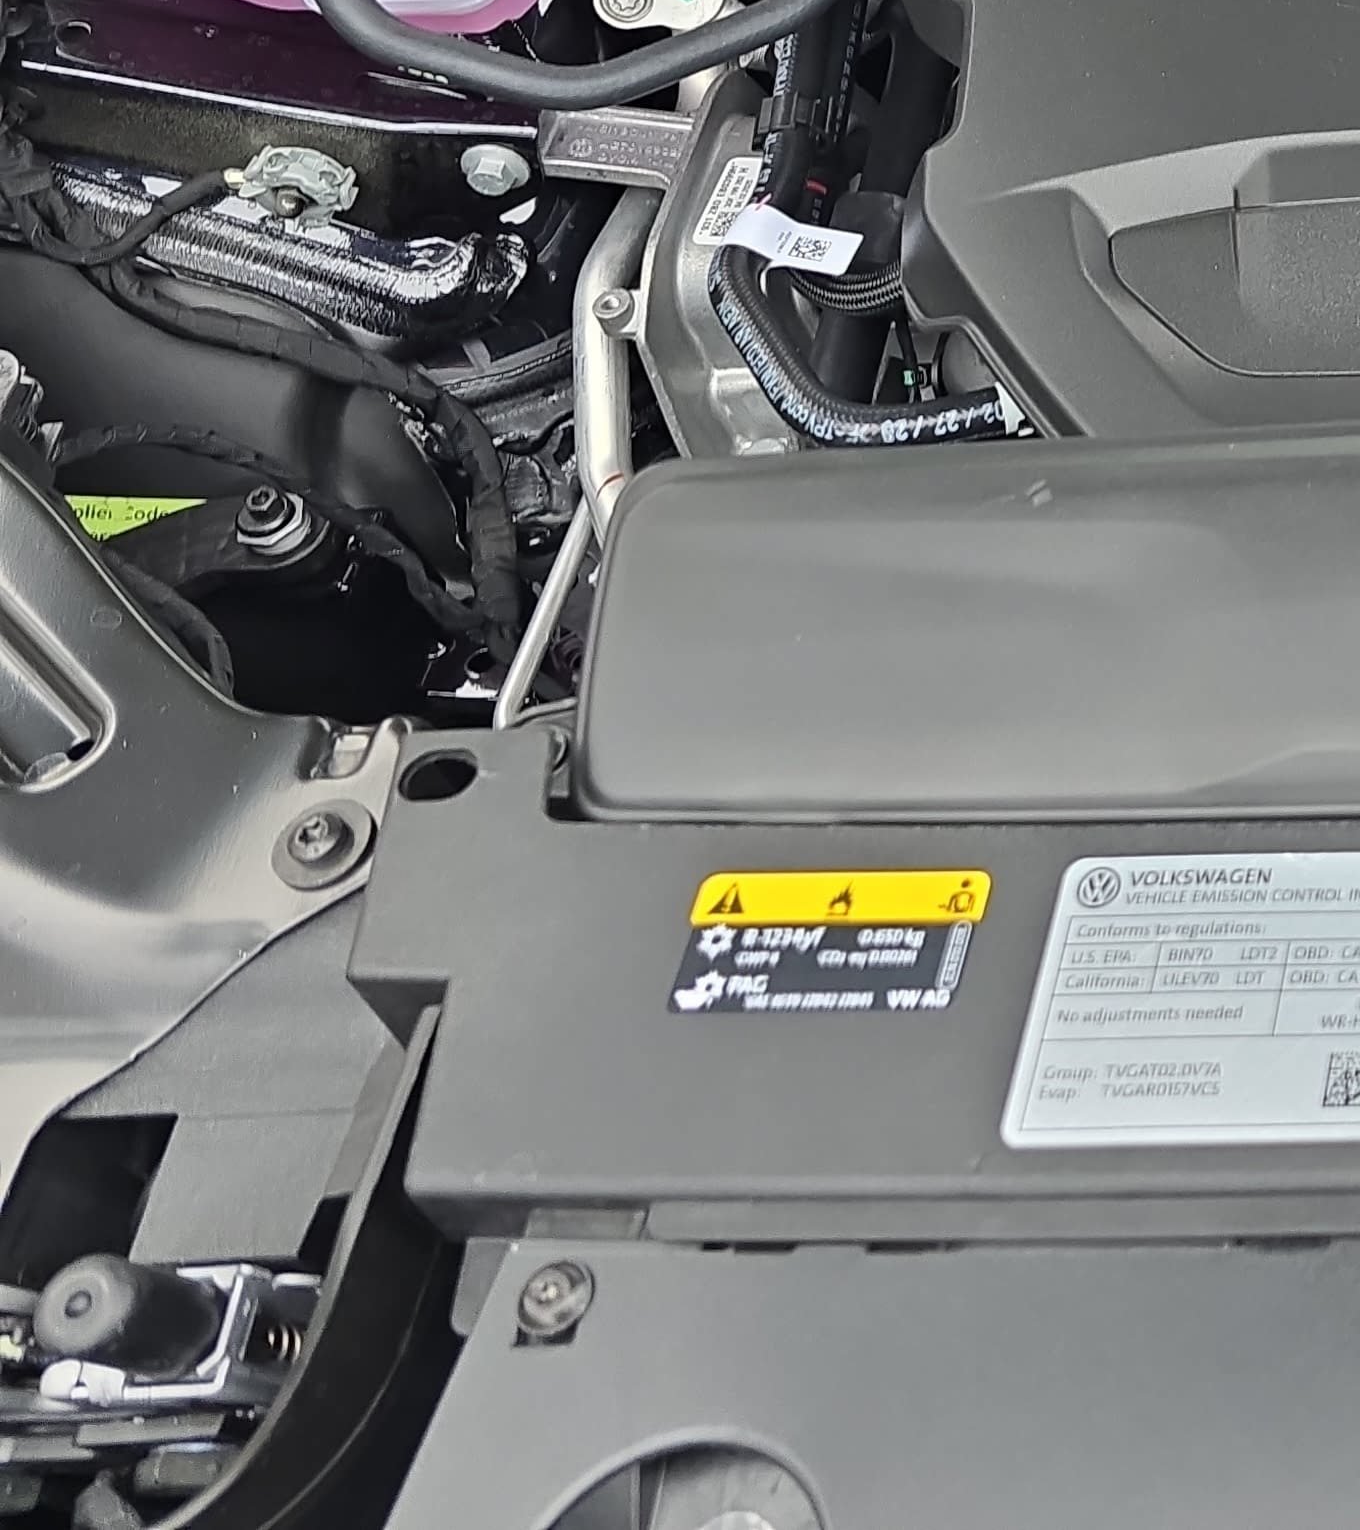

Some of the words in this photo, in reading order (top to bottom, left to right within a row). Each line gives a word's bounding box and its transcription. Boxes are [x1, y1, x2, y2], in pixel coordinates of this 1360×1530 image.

[1131, 868, 1272, 886] VOLKSWAGEN
[1126, 889, 1187, 904] VEHICLE
[1192, 888, 1267, 903] EMISSION
[1272, 887, 1342, 902] CONTROL
[904, 928, 926, 948] kg
[1077, 923, 1150, 937] Conforms
[1156, 923, 1171, 935] to
[1103, 949, 1136, 963] EPA:
[1168, 947, 1213, 961] BIN70
[1240, 946, 1277, 960] LDT2
[1294, 945, 1333, 959] OBD:
[1065, 973, 1144, 989] California:
[1163, 972, 1219, 985] ULEV70
[1236, 971, 1265, 985] LDT
[1290, 970, 1329, 984] OBD:
[1338, 969, 1360, 983] CA
[727, 975, 769, 997] PAG
[887, 989, 922, 1010] VW
[920, 989, 951, 1009] AG
[1057, 1009, 1079, 1022] No
[1083, 1007, 1180, 1025] adjustments
[1185, 1005, 1243, 1019] needed
[1043, 1065, 1097, 1082] Group:
[1039, 1085, 1080, 1102] Evap:
